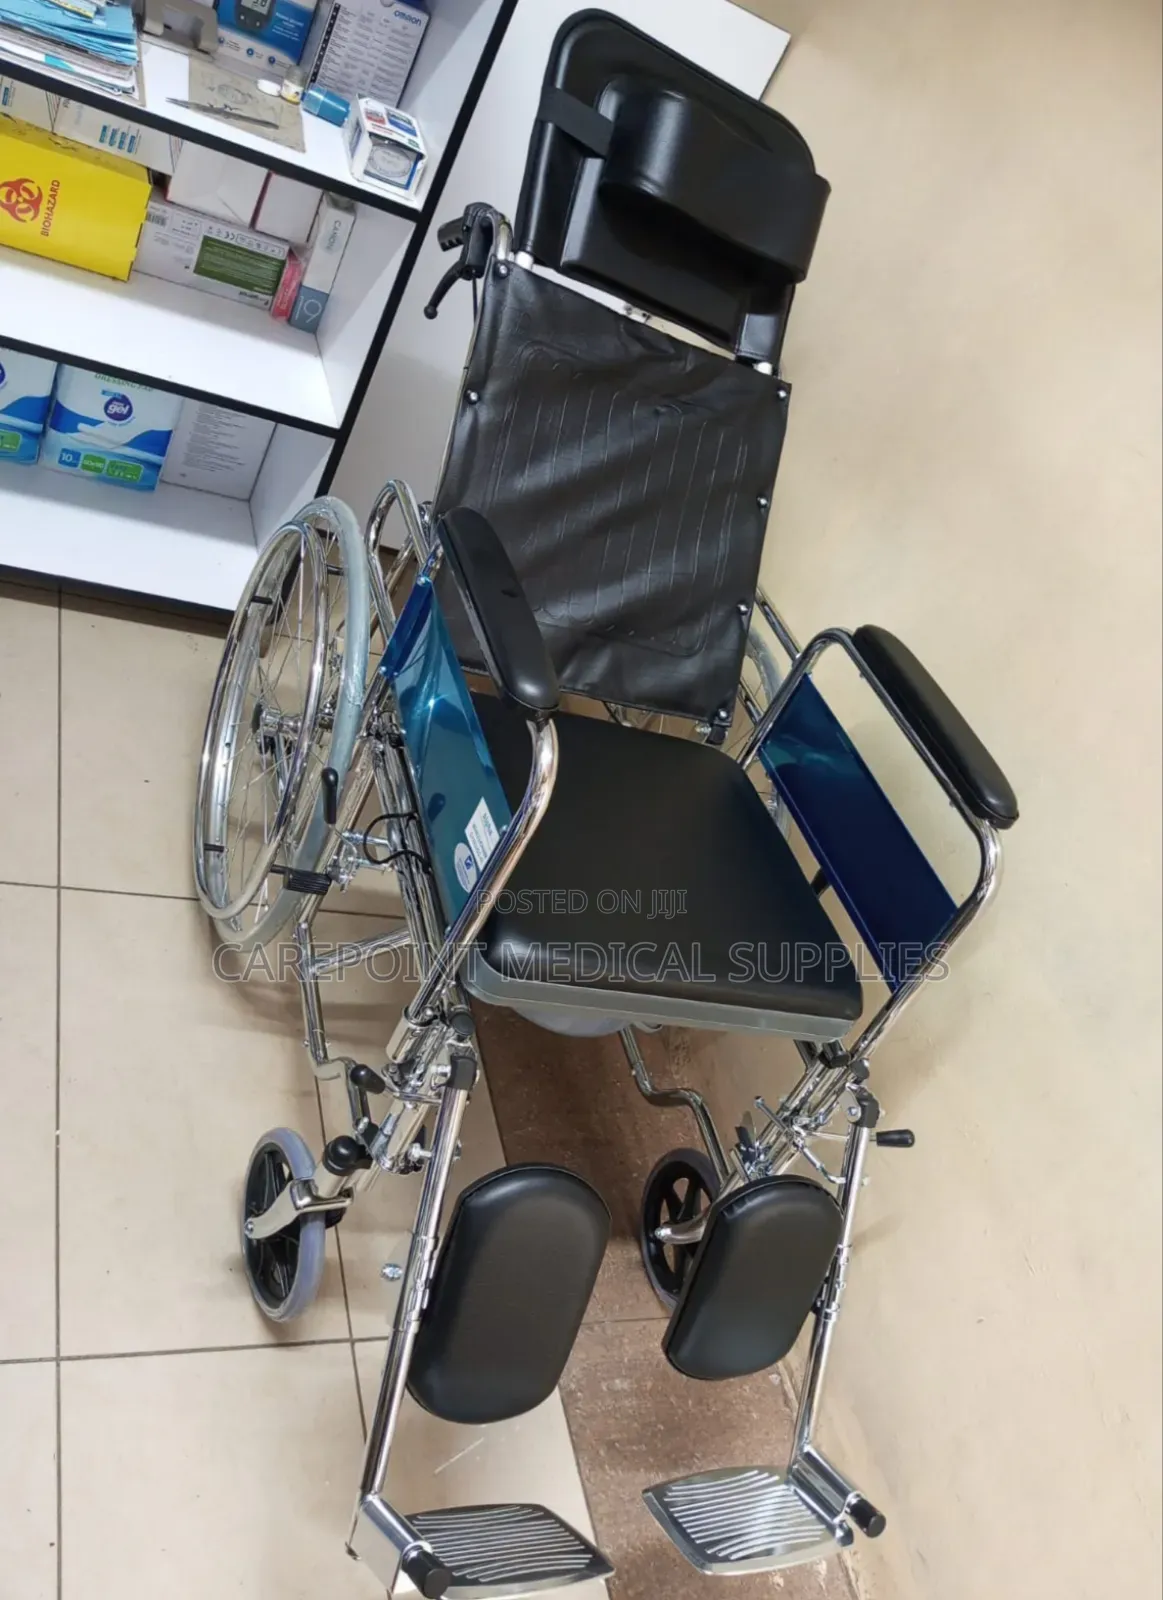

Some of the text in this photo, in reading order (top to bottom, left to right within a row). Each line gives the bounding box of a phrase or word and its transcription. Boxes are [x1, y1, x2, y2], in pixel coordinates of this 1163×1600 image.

[40, 179, 60, 237] BIOHAZARD
[295, 295, 323, 323] 19
[106, 404, 130, 415] gel
[61, 452, 74, 463] 10
